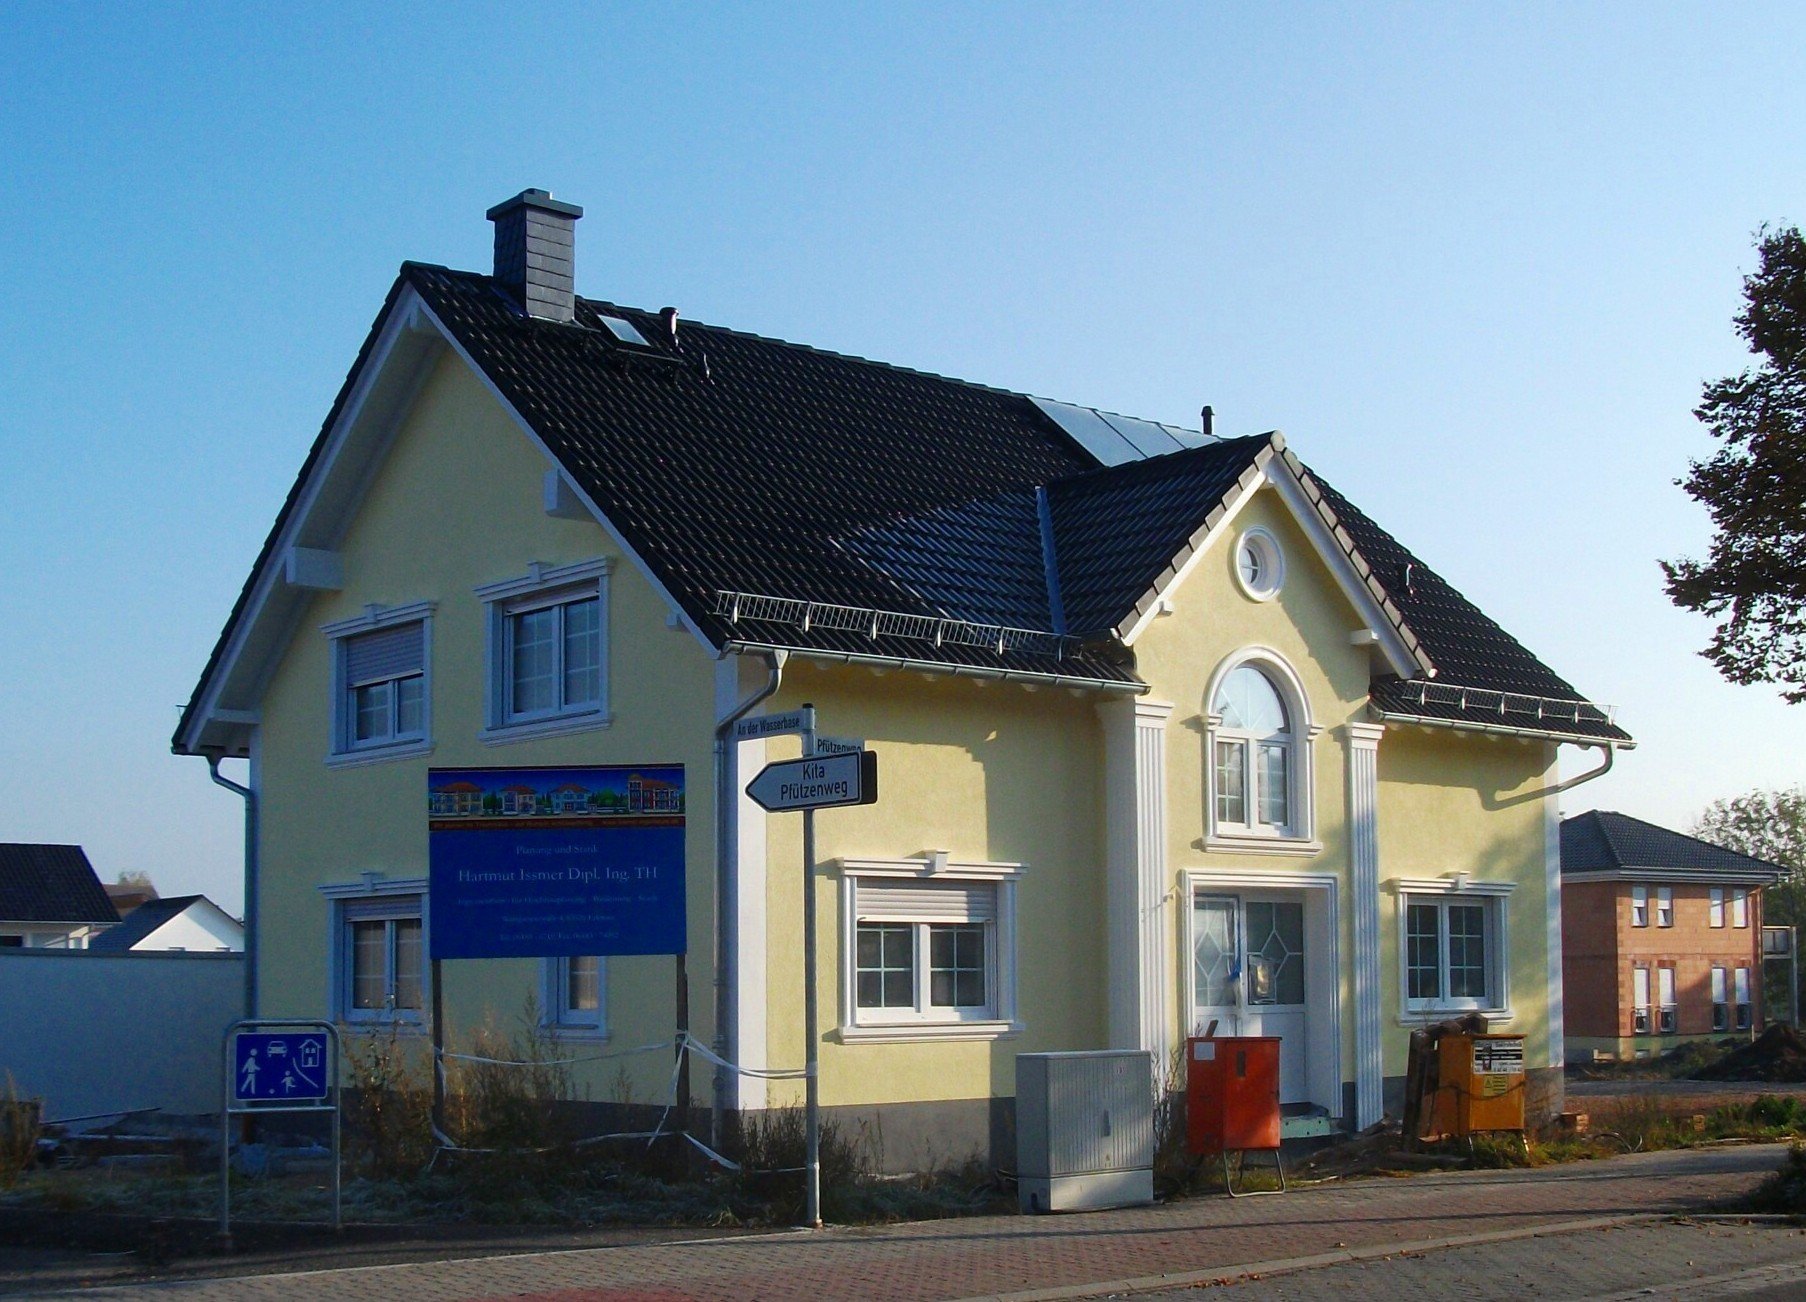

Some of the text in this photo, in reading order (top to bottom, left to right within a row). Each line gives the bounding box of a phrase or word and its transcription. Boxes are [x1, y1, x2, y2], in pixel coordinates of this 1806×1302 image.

[737, 723, 746, 736] An
[747, 721, 758, 735] der
[802, 764, 825, 781] Kita
[780, 780, 848, 801] Pfützenweg
[554, 844, 572, 854] und
[458, 866, 658, 884] Hartmut Issmer Dipl. Ing. TH
